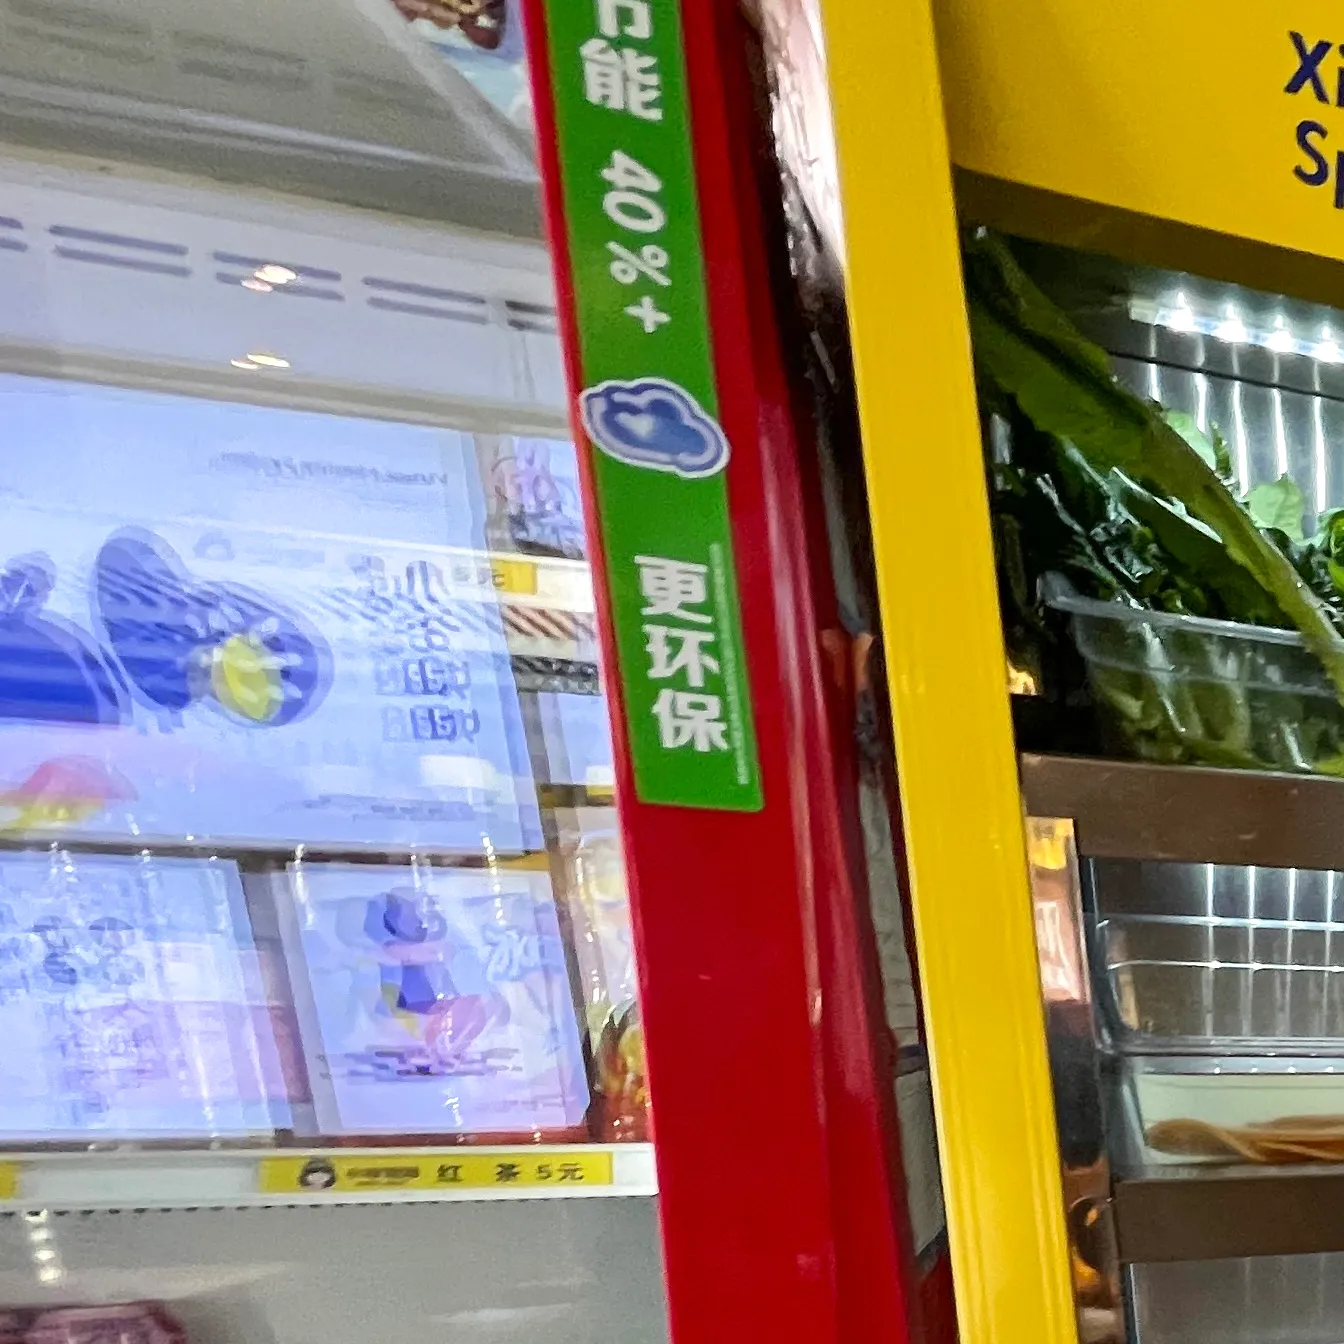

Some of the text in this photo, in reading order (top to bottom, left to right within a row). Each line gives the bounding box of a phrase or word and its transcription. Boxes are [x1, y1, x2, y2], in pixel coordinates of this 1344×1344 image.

[600, 149, 672, 334] 40%+
[634, 554, 729, 753] 更环保
